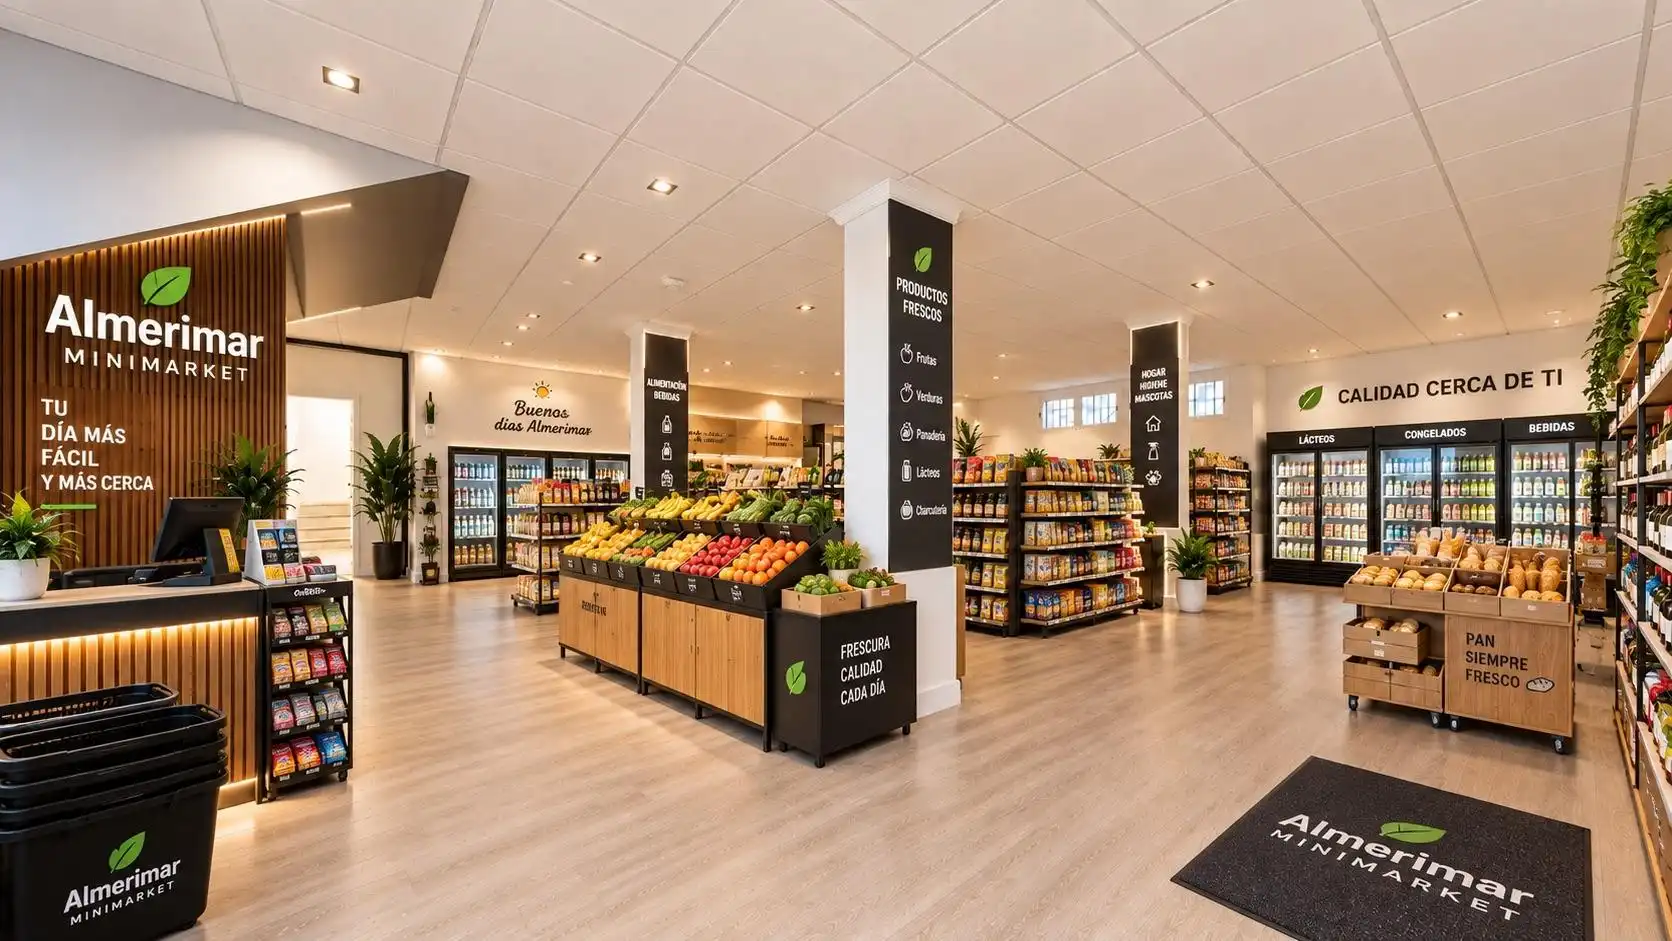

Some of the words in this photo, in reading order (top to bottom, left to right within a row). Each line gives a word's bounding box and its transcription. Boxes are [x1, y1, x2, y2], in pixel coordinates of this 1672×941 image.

[897, 277, 948, 306] PRODUCTOS
[903, 298, 942, 322] FRESCOS
[45, 294, 264, 359] Almerimar
[65, 347, 248, 382] MINIMARKET
[917, 352, 937, 366] Frutas
[1141, 367, 1166, 379] HOGAR
[1135, 391, 1173, 403] MASCOTAS
[1339, 382, 1420, 404] CALIDAD
[1427, 375, 1497, 396] CERCA
[1505, 371, 1534, 389] DE
[1541, 368, 1563, 387] TI
[41, 398, 68, 417] TU
[41, 421, 77, 442] DÍA
[84, 423, 126, 444] MÁS
[526, 419, 592, 436] Almerimar
[1404, 427, 1467, 440] CONGELADOS
[1528, 421, 1576, 434] BEBIDAS
[1298, 434, 1335, 445] LÁCTEOS
[41, 445, 99, 467] FÁCIL
[41, 474, 54, 491] Y
[59, 471, 97, 491] MÁS
[101, 474, 154, 491] CERCA
[841, 635, 891, 660] FRESCURA
[1466, 632, 1495, 648] PAN
[841, 659, 883, 682] CALIDAD
[1466, 650, 1529, 671] SIEMPRE
[1466, 668, 1520, 689] FRESCO
[841, 685, 868, 706] CADA
[870, 678, 886, 698] DÍA
[1279, 813, 1535, 905] Almerimar
[1270, 829, 1520, 921] MINIMARKET
[63, 859, 181, 914] Almerimar
[70, 880, 175, 926] MINIMARKET
